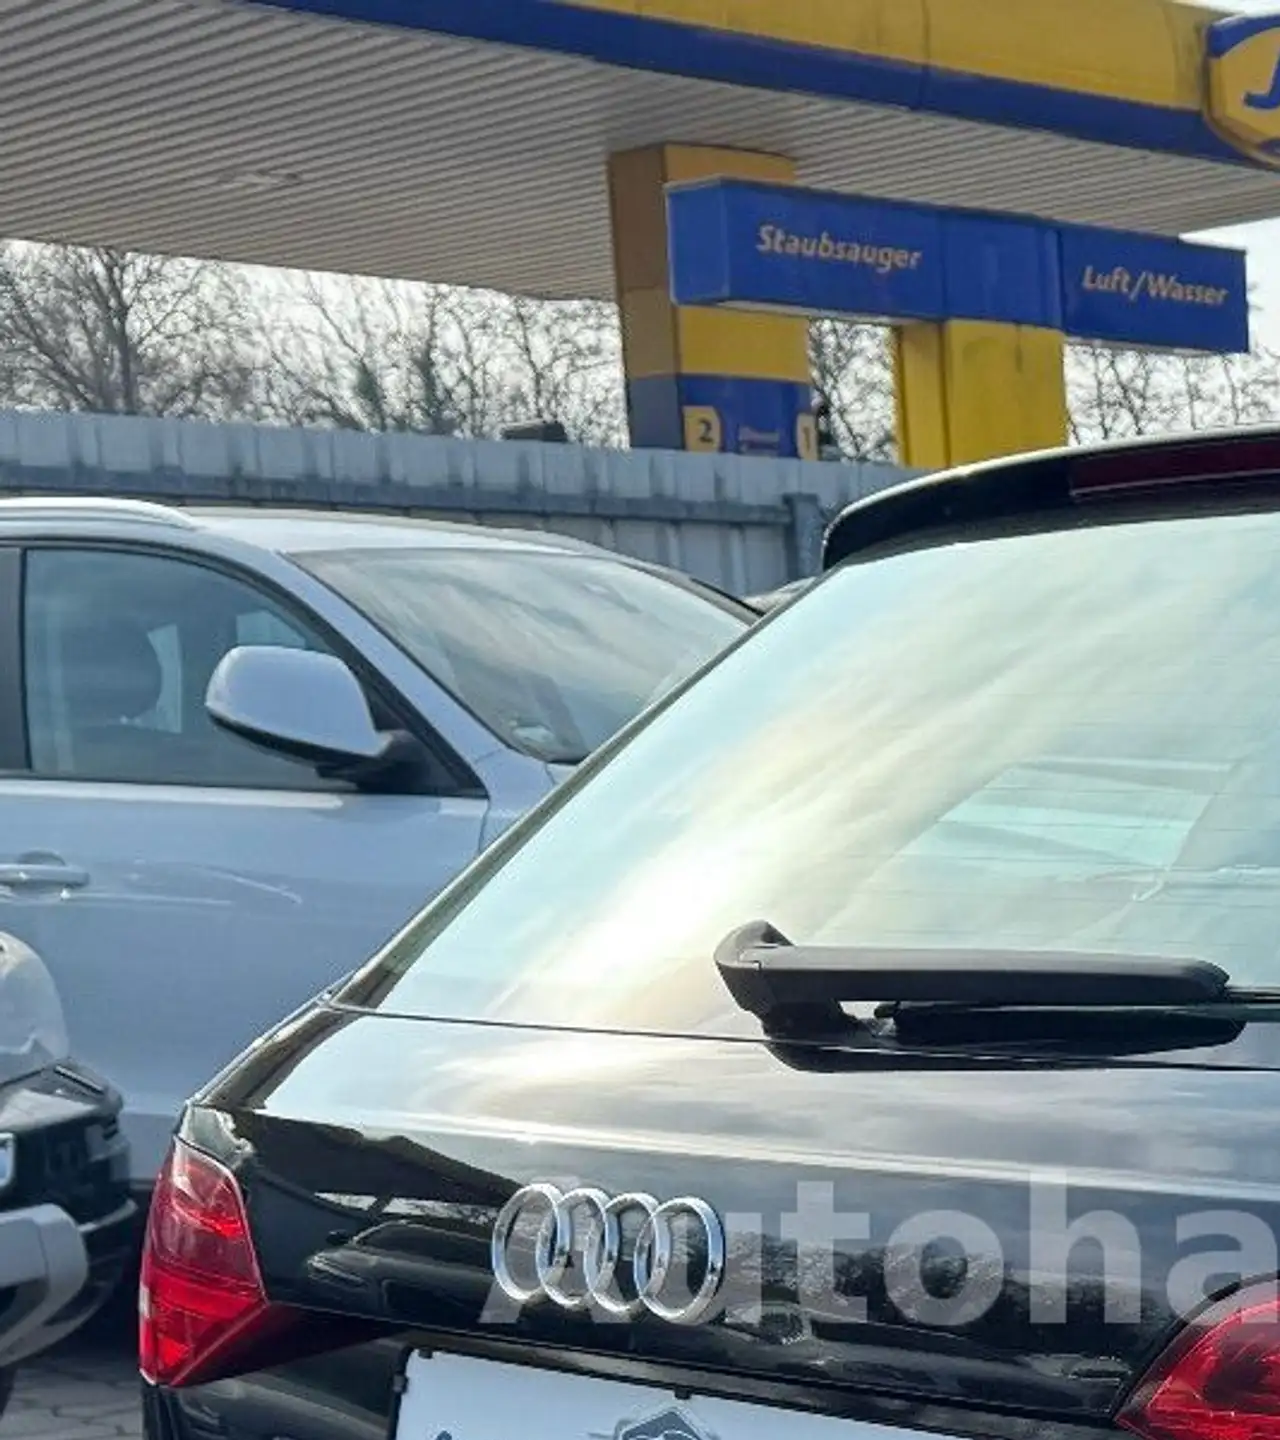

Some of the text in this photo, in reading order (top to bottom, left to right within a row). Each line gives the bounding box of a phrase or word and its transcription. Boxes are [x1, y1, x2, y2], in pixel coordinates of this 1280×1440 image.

[756, 223, 923, 274] Staubsauger
[1082, 264, 1230, 305] Luft/Wasser
[698, 418, 714, 443] 2
